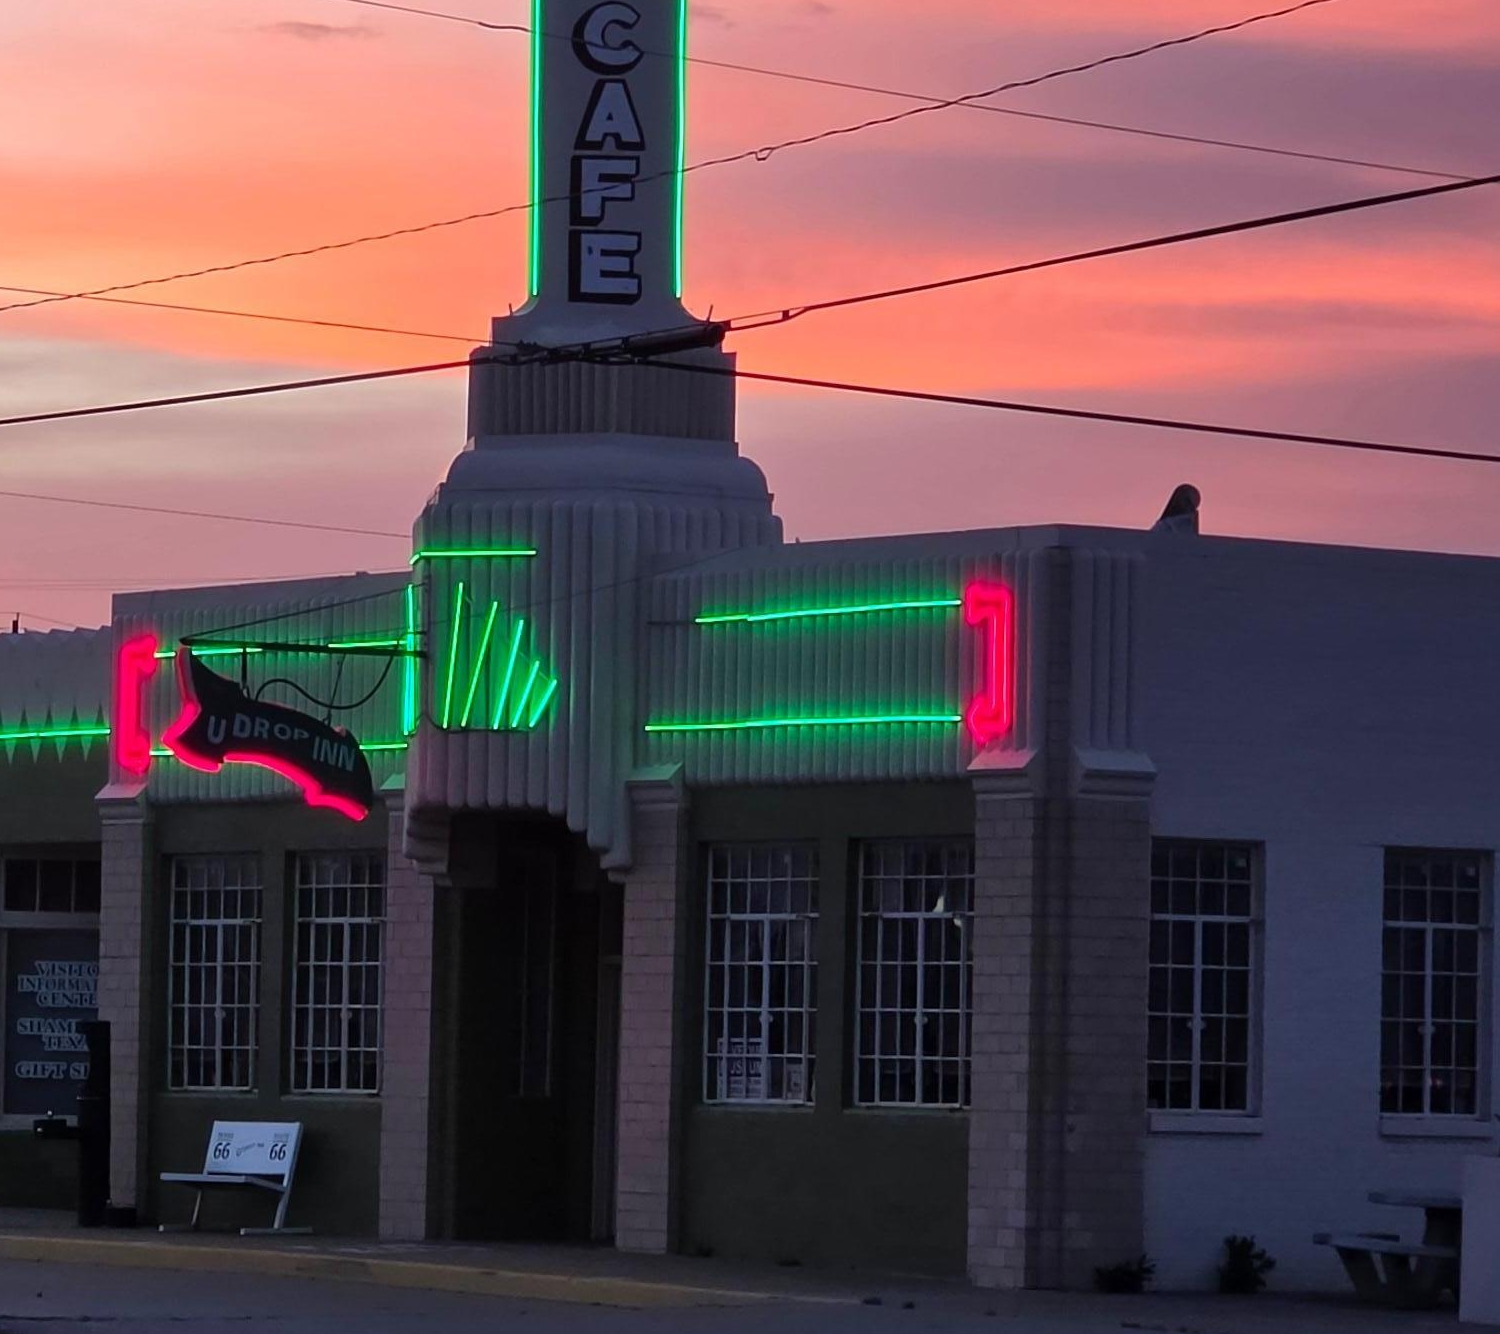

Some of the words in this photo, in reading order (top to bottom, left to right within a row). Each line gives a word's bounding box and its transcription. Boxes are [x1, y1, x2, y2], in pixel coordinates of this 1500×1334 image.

[568, 0, 646, 305] CAFE
[207, 715, 228, 745] U
[232, 712, 310, 740] DROP
[311, 735, 356, 772] INN
[35, 961, 100, 976] VISITO
[15, 1060, 67, 1078] GIFT
[213, 1142, 231, 1160] 66
[269, 1143, 288, 1161] 66
